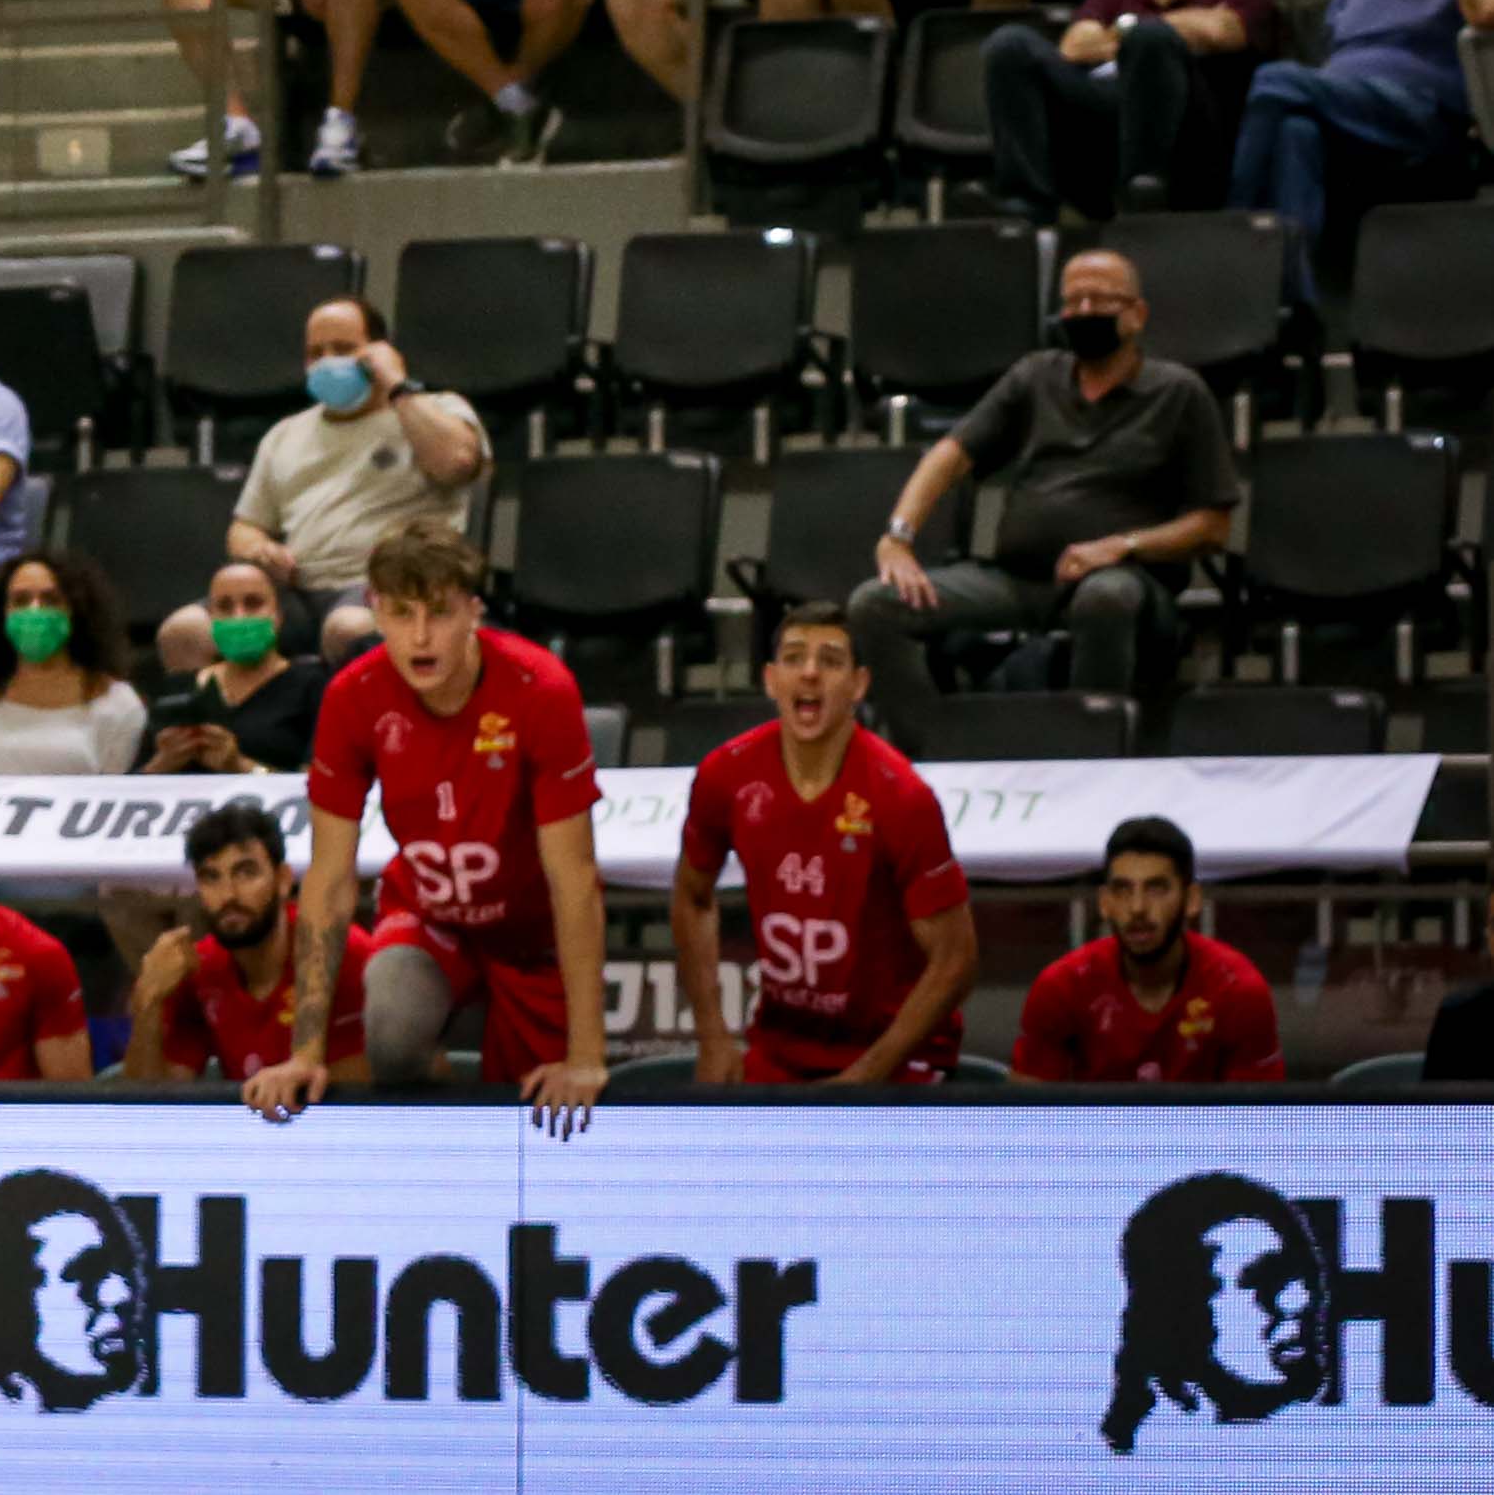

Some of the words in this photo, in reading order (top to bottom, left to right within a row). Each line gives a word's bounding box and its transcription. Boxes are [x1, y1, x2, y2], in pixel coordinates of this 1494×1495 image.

[436, 780, 457, 821] 1
[402, 840, 500, 904] SP
[776, 851, 826, 896] 44
[761, 911, 850, 987] SP
[116, 1195, 819, 1404] Hunter
